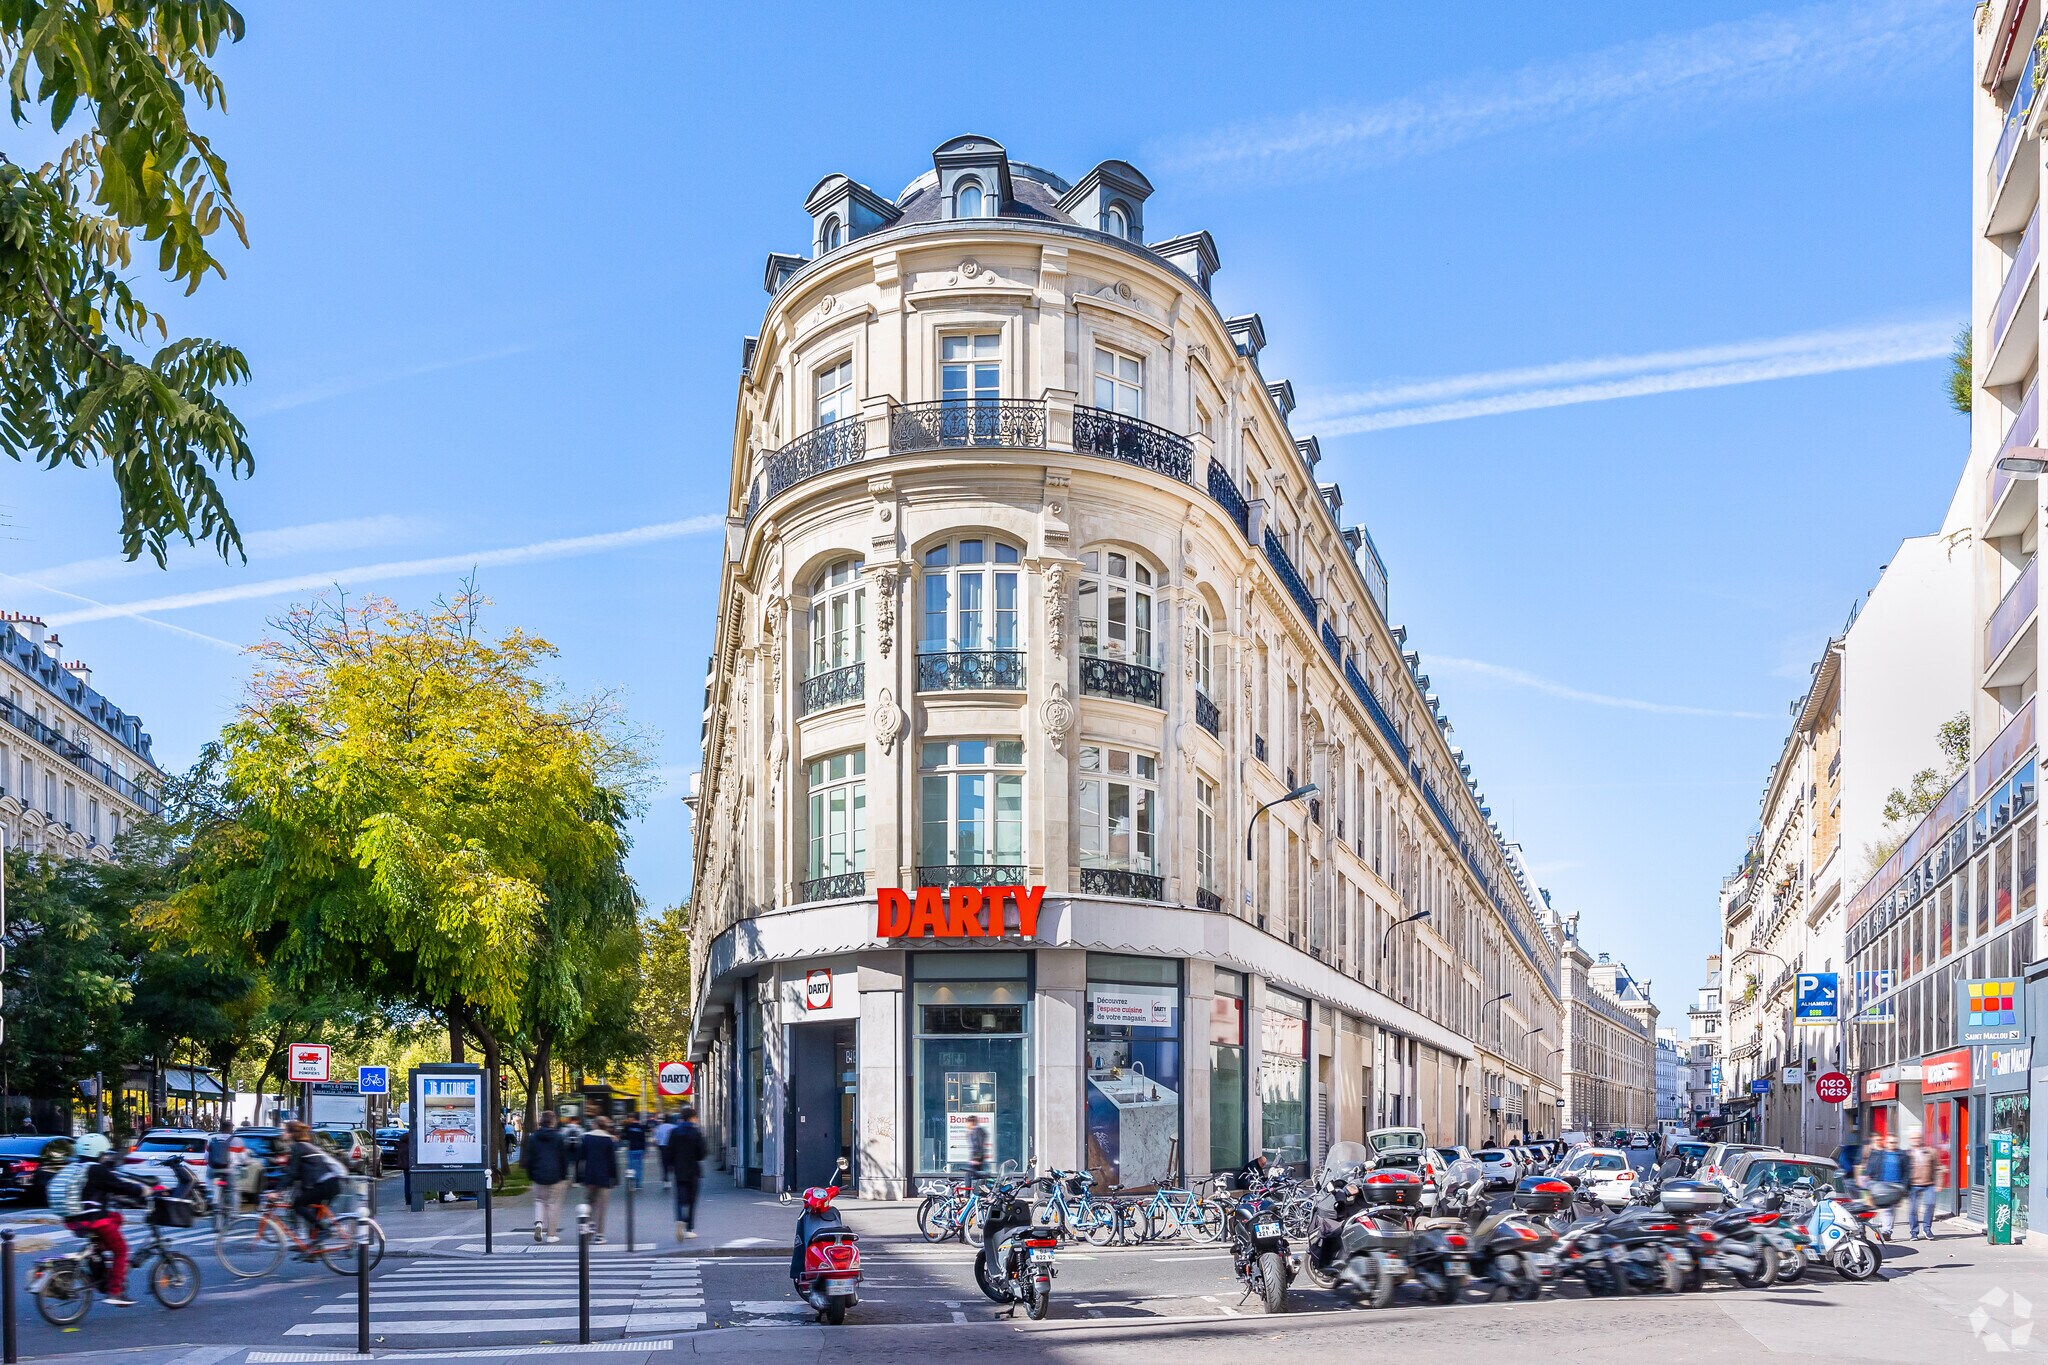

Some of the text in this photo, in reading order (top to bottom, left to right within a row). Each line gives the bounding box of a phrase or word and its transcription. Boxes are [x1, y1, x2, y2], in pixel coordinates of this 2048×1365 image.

[877, 886, 1047, 937] DARTY
[808, 982, 830, 995] DARTY
[1799, 976, 1819, 999] P
[1097, 997, 1128, 1005] Découvrez
[1097, 1005, 1120, 1013] l'espace
[1122, 1015, 1147, 1023] magasin
[1965, 1032, 2008, 1041] SAINT MACLOU
[1997, 1051, 2011, 1076] SAINT
[661, 1074, 690, 1083] DARTY
[1820, 1079, 1846, 1087] neo
[1820, 1088, 1848, 1096] ness
[2000, 1142, 2009, 1154] P
